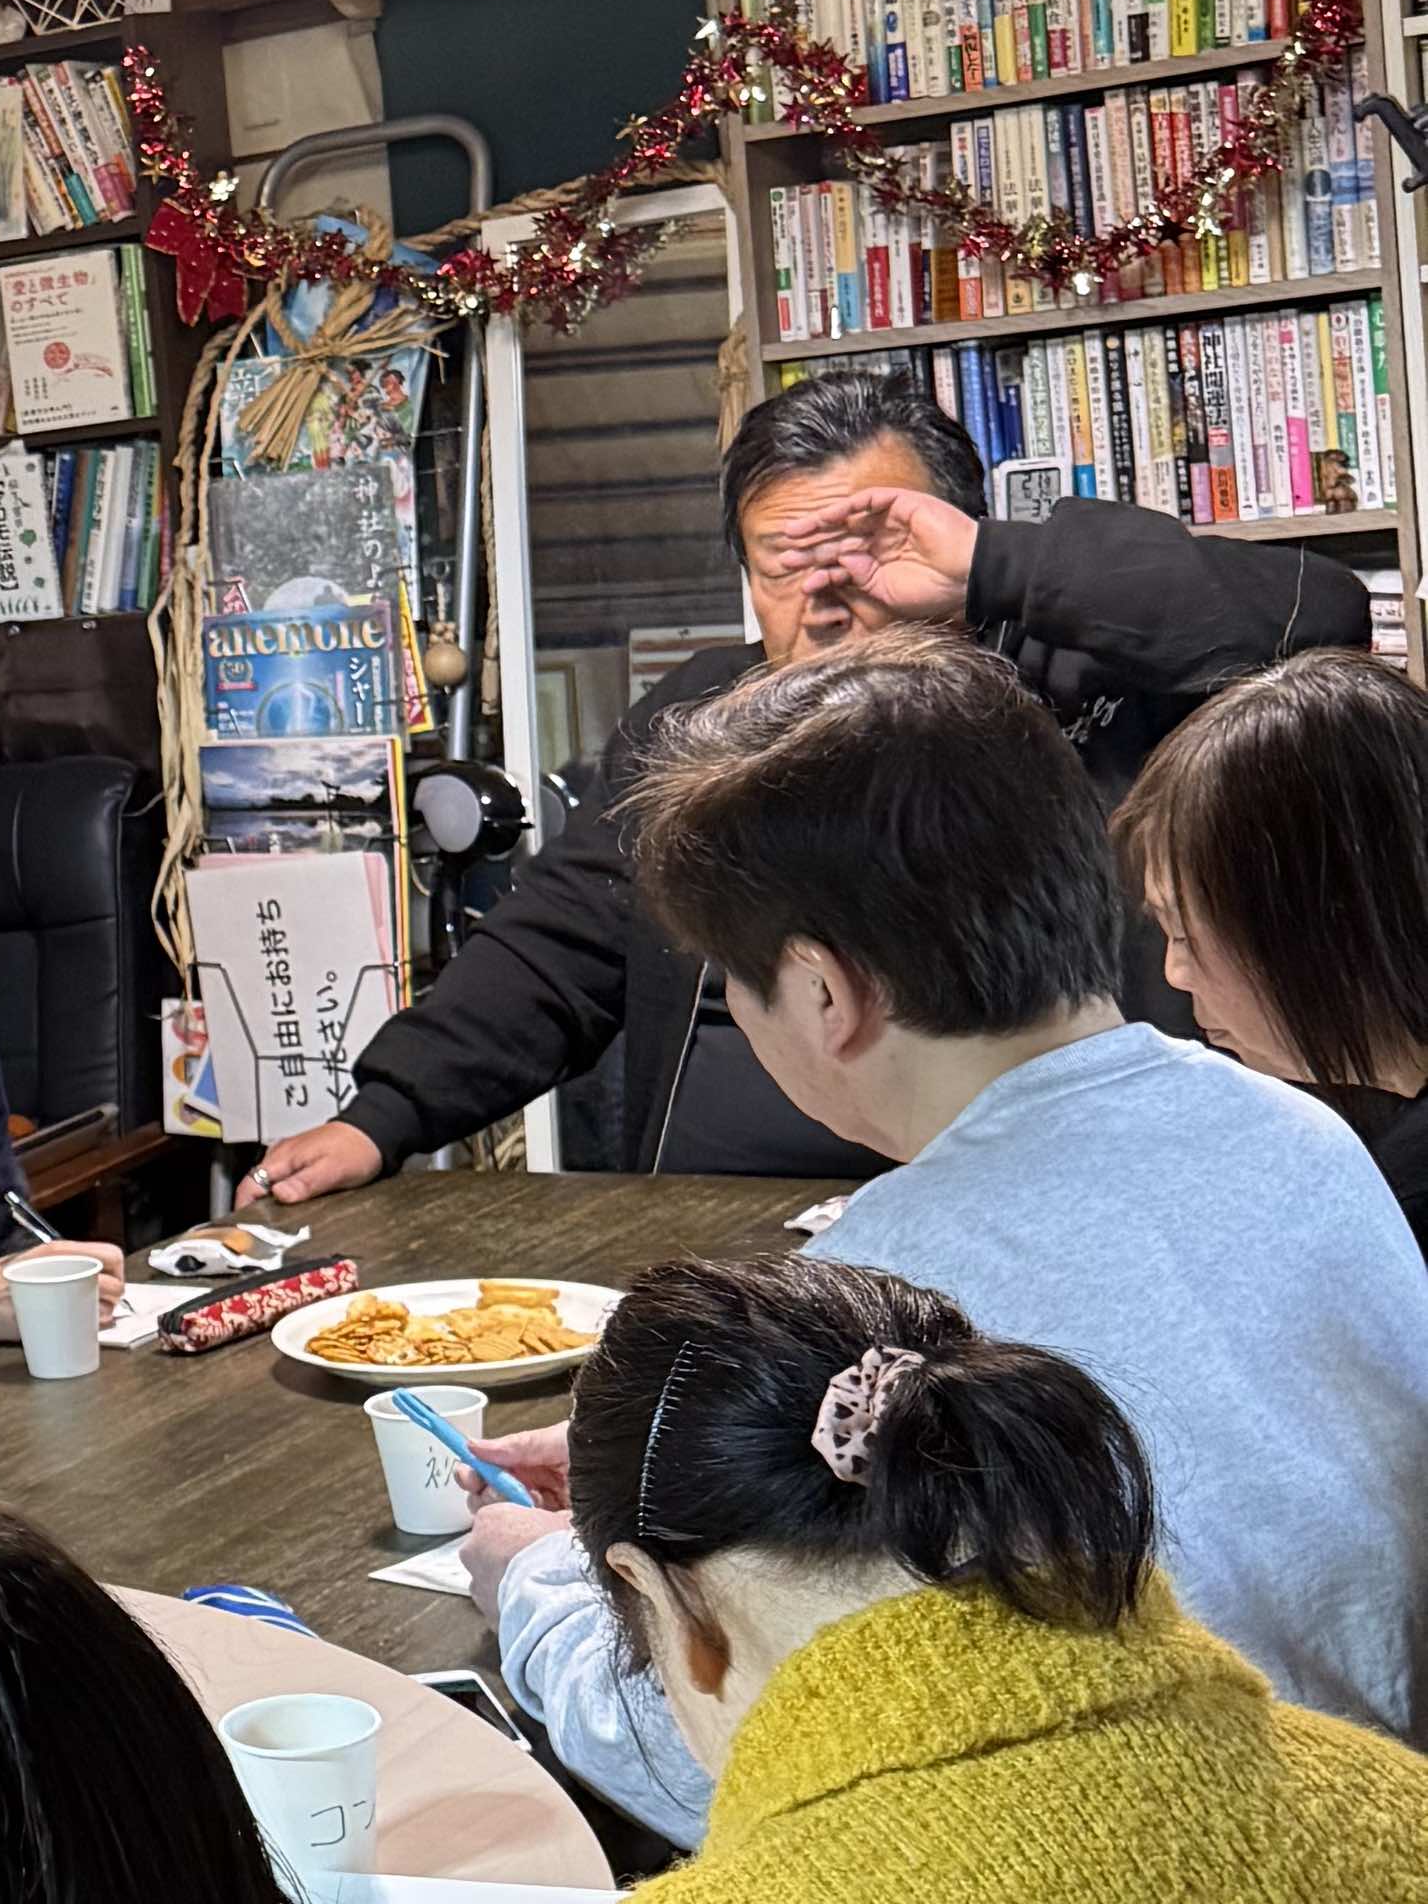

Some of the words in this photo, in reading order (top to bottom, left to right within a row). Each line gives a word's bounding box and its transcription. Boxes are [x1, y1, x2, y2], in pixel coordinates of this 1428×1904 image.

[353, 477, 384, 589] 神社のよ
[207, 617, 387, 659] anemone
[256, 898, 310, 1109] ご自由にお持ち
